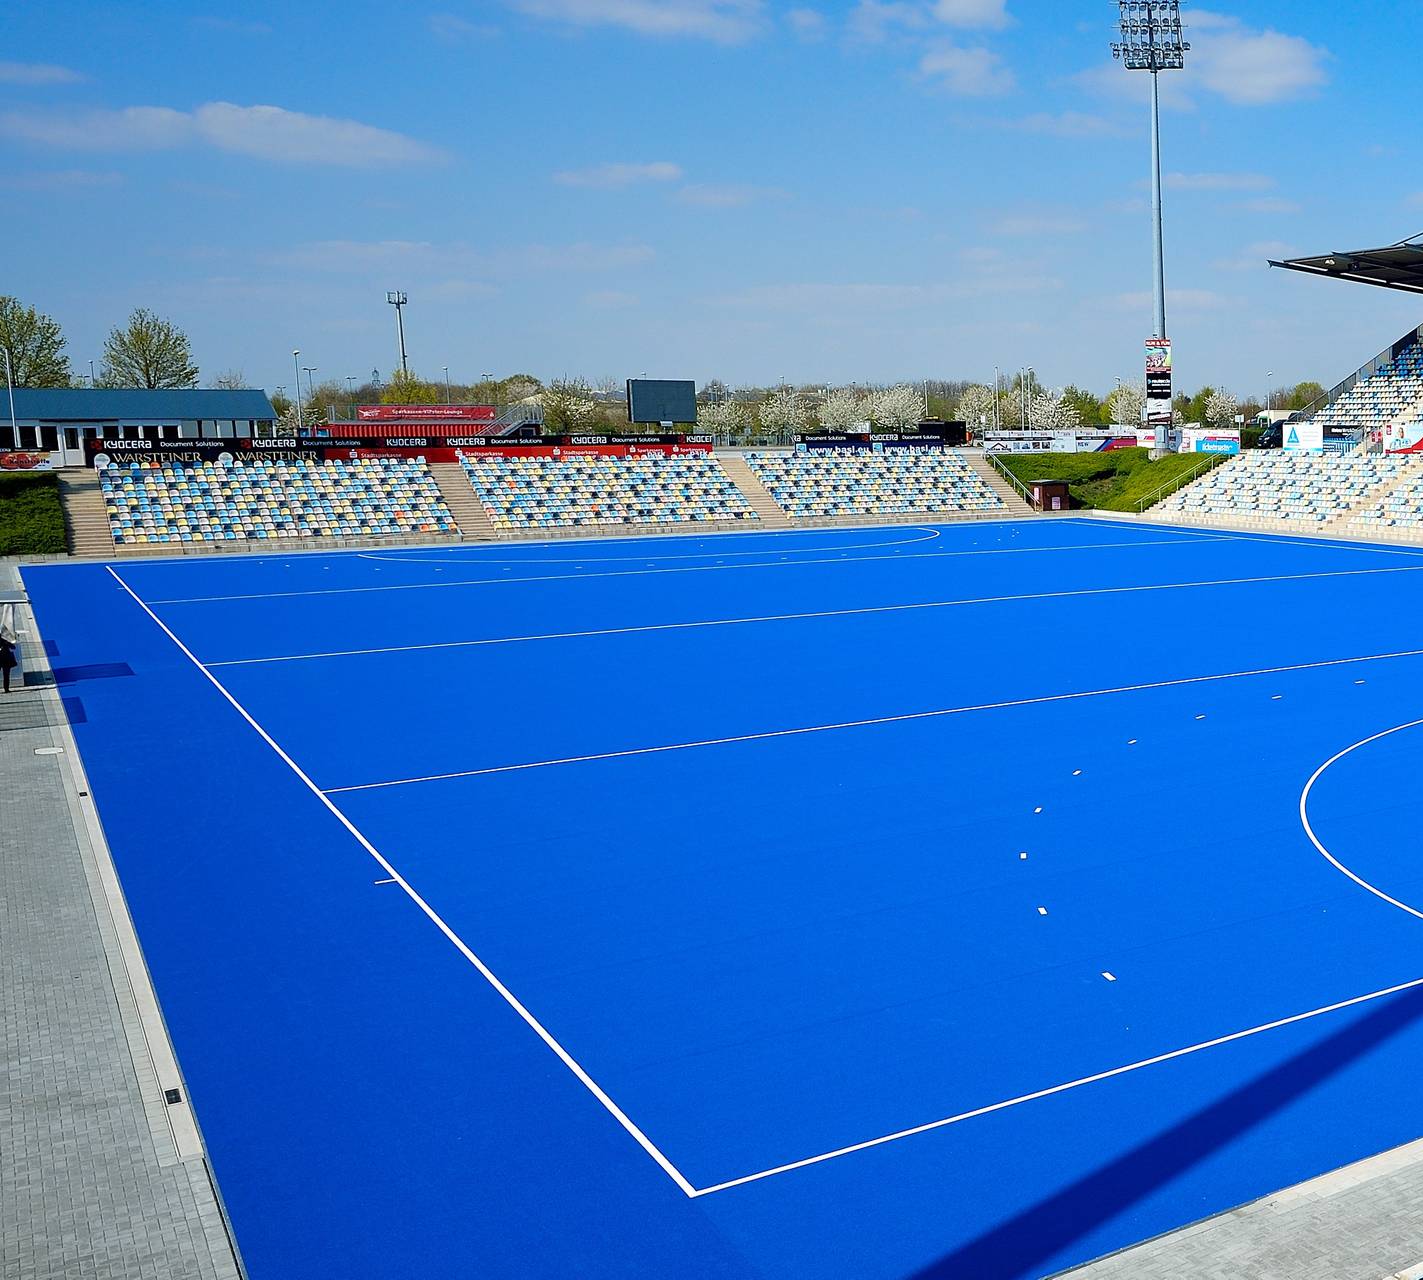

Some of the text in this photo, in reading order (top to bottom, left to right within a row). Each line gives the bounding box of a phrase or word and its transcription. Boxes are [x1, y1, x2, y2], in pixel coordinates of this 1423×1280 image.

[252, 439, 296, 447] KYOCERA
[386, 438, 426, 446] KYOCERA
[571, 436, 607, 444] KYOCERA
[104, 440, 152, 449] KYOCERA
[112, 452, 203, 463] WARSTEINER
[235, 451, 318, 461] WARSTEINER
